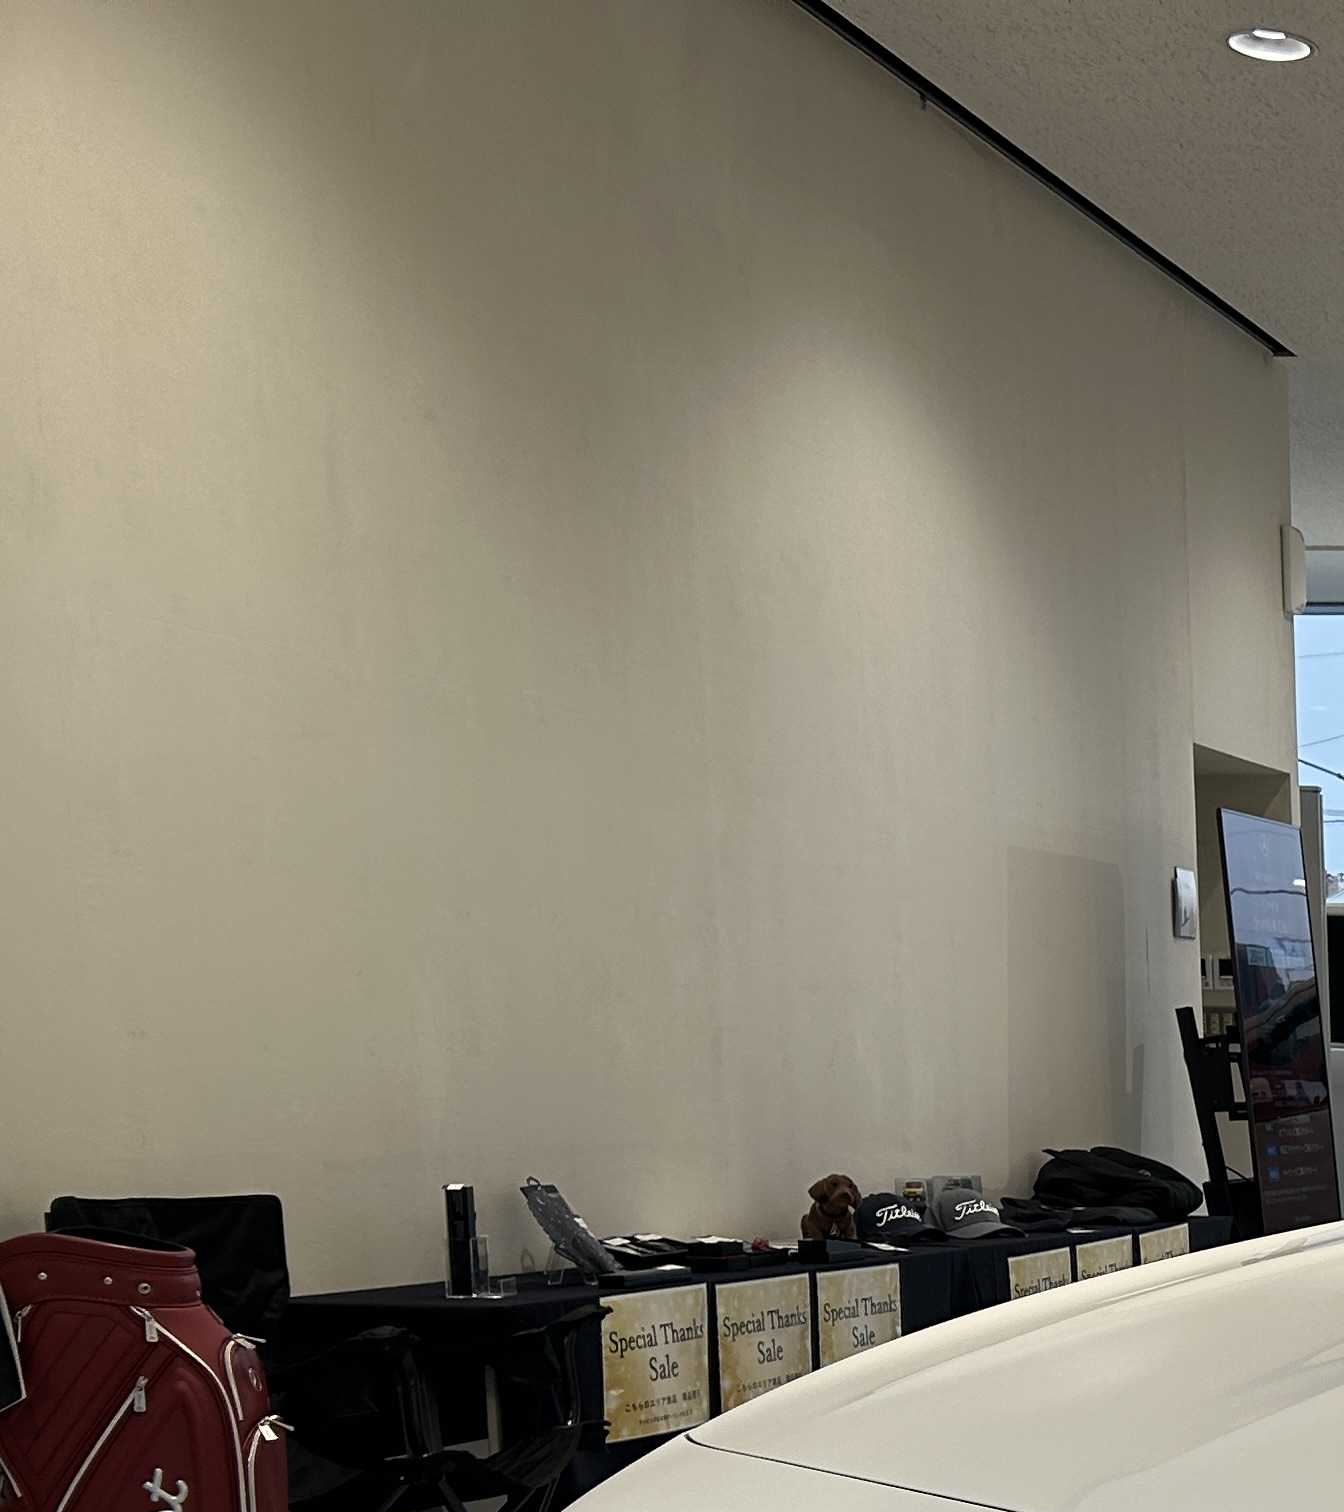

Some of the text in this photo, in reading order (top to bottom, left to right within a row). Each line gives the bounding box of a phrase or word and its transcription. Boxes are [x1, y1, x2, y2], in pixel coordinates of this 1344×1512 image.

[722, 1305, 807, 1342] Special Thanks
[823, 1294, 897, 1326] Special Thanks
[608, 1318, 704, 1358] Special Thanks
[757, 1338, 783, 1364] Sale
[852, 1325, 876, 1349] Sale
[649, 1354, 679, 1381] Sale
